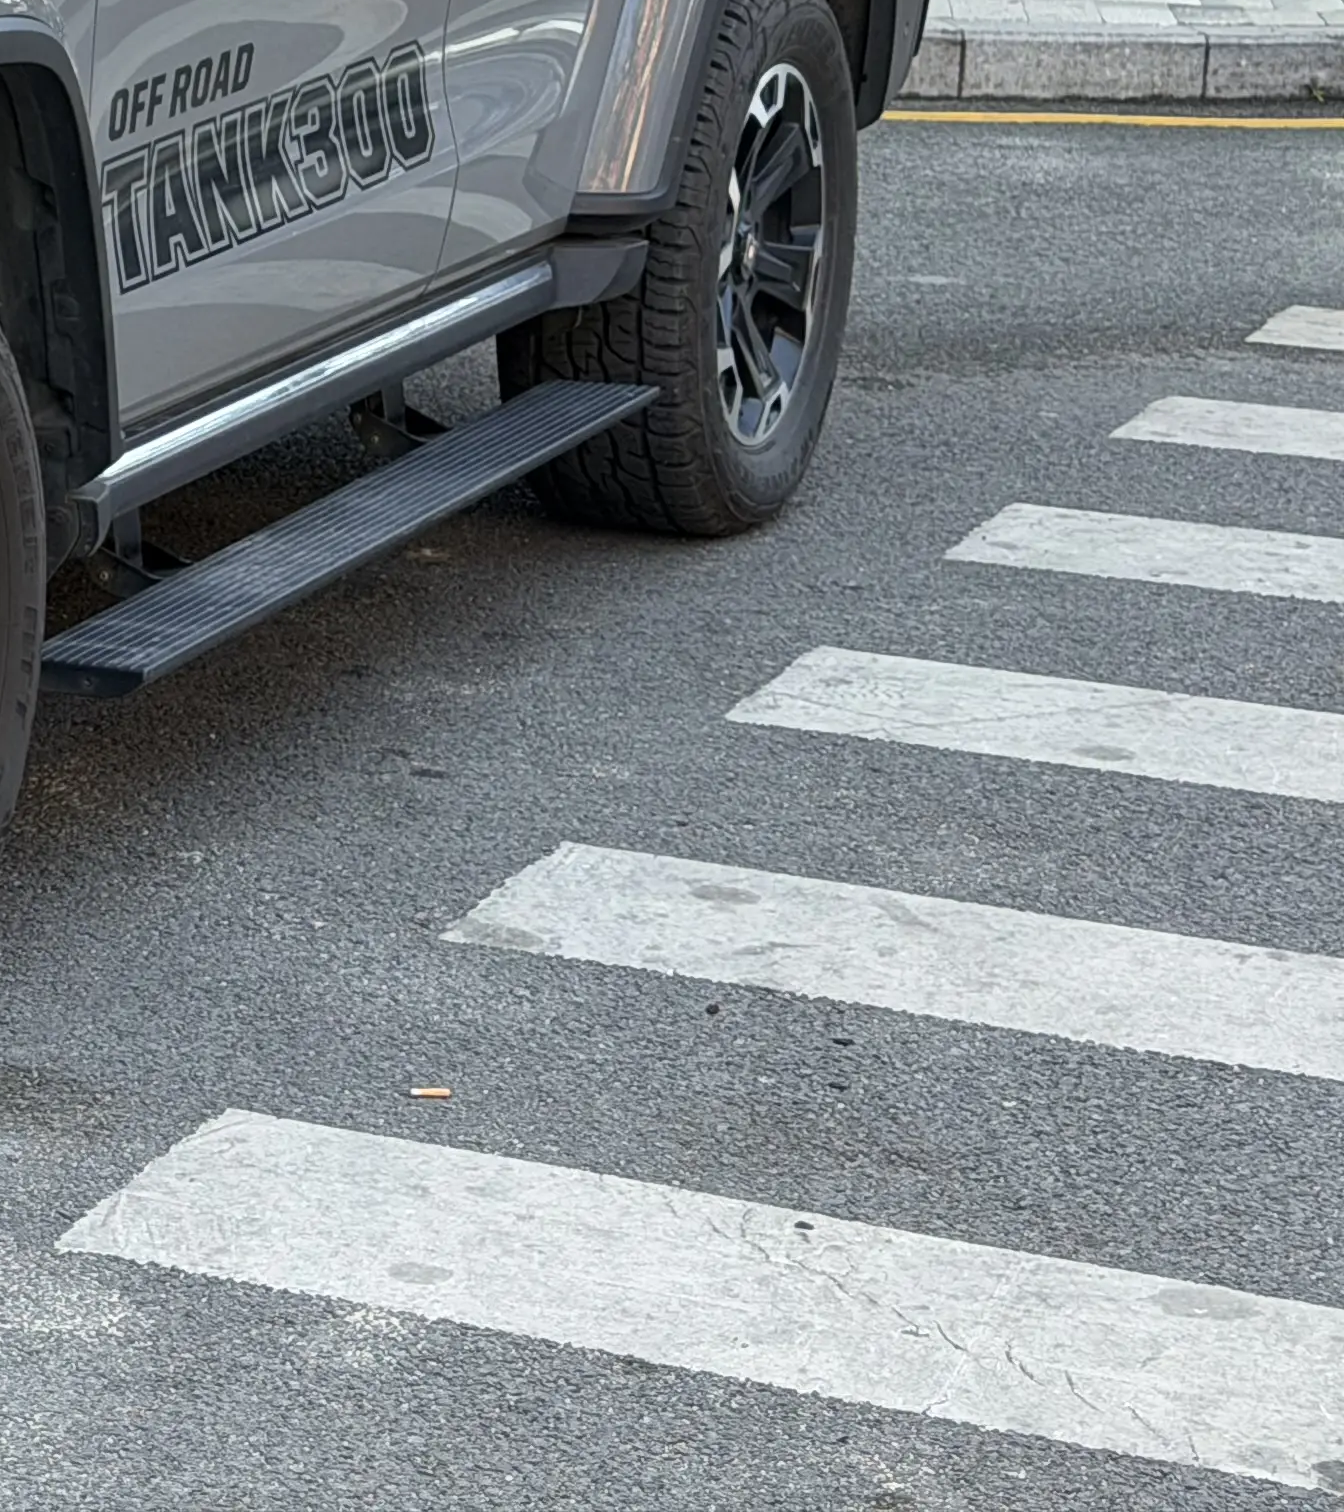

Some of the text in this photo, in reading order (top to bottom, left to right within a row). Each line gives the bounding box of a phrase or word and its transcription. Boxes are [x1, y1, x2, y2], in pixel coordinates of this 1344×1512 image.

[100, 39, 435, 295] TANK300
[108, 42, 255, 141] OFF ROAD
